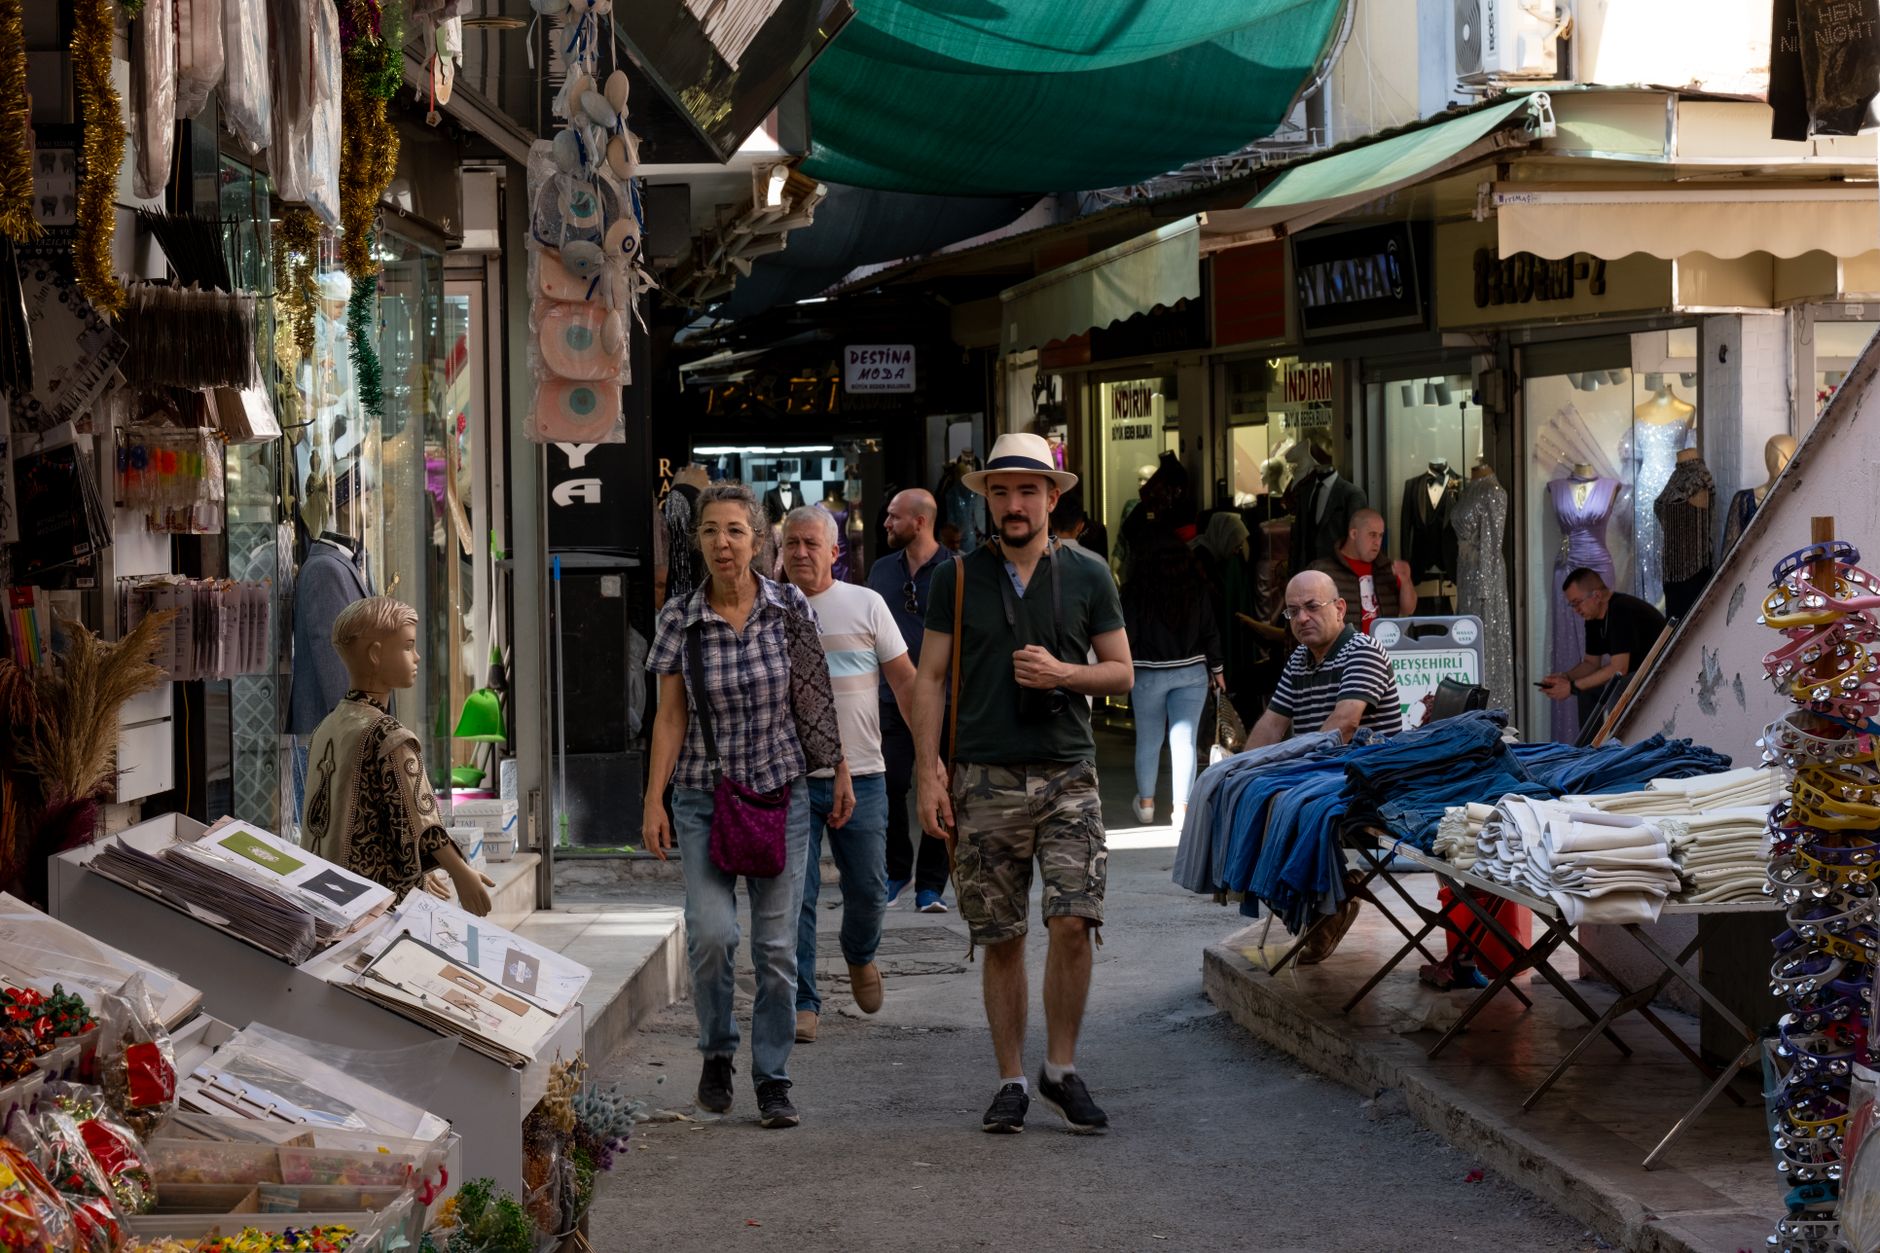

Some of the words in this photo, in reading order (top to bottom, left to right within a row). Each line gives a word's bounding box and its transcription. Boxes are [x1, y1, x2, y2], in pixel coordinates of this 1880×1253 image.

[1818, 1, 1863, 25] HEN
[1814, 19, 1876, 47] NIGHT
[849, 347, 911, 365] DESTİNA
[857, 367, 905, 381] MODA
[1111, 381, 1152, 420] İNDİRİM
[1392, 653, 1463, 673] BEYŞEHİRLİ
